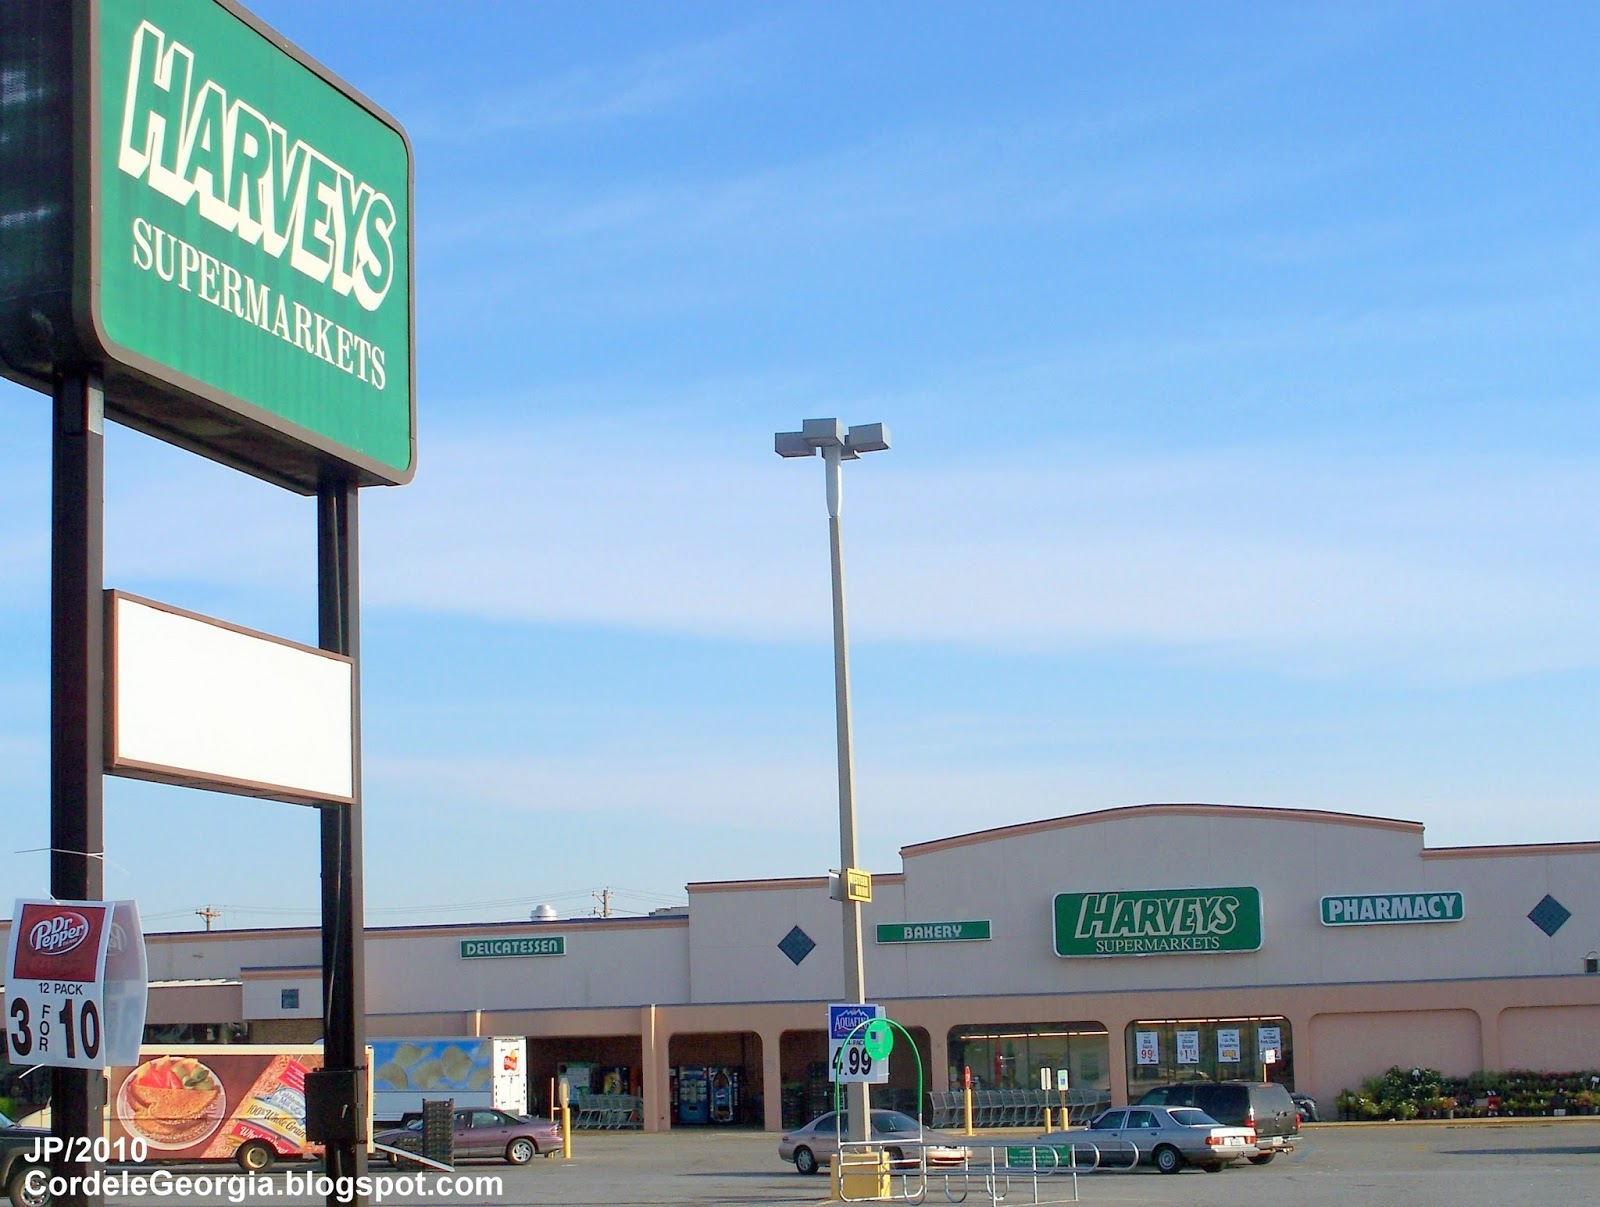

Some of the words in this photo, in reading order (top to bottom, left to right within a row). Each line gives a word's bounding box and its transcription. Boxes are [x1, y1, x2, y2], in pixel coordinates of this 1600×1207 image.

[118, 19, 397, 312] HARVEYS
[132, 217, 386, 391] SUPERMARKETS
[1074, 893, 1240, 939] HARVEYS
[1328, 896, 1457, 921] PHARMACY
[35, 920, 85, 951] Pepper
[52, 916, 73, 933] Dr
[903, 925, 962, 939] BAKERY
[466, 940, 558, 955] DELICATESSEN
[1096, 937, 1220, 953] SUPERMARKETS
[38, 983, 50, 994] 12
[54, 983, 83, 995] PACK
[10, 997, 32, 1056] 3
[59, 998, 100, 1060] 10
[832, 1047, 871, 1075] 4.99
